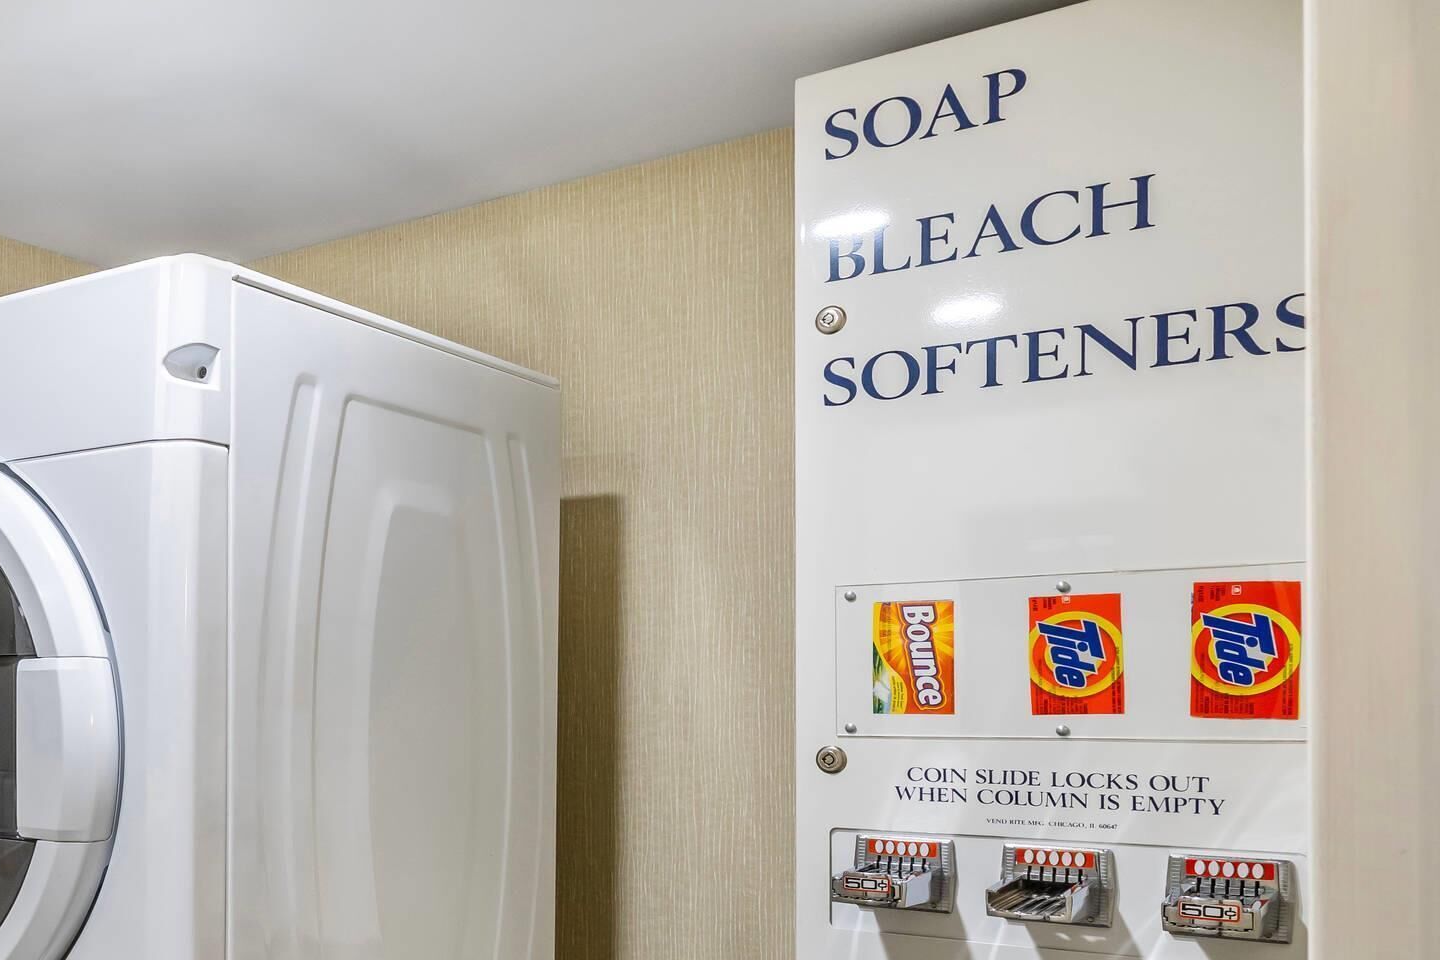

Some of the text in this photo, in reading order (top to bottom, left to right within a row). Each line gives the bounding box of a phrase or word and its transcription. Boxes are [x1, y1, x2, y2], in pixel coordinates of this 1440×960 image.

[824, 68, 1027, 160] SOAP
[824, 173, 1156, 282] BLEACH
[823, 293, 1306, 407] SOFTENERS
[902, 605, 942, 705] Bounce
[1036, 619, 1107, 689] Tide
[1200, 612, 1278, 688] Tide
[895, 785, 1226, 816] WHEN COLUMN IS EMPTY
[907, 766, 1210, 793] COIN SLIDE LOCKS OUT
[845, 877, 888, 891] 50¢
[1181, 903, 1237, 920] 50¢
